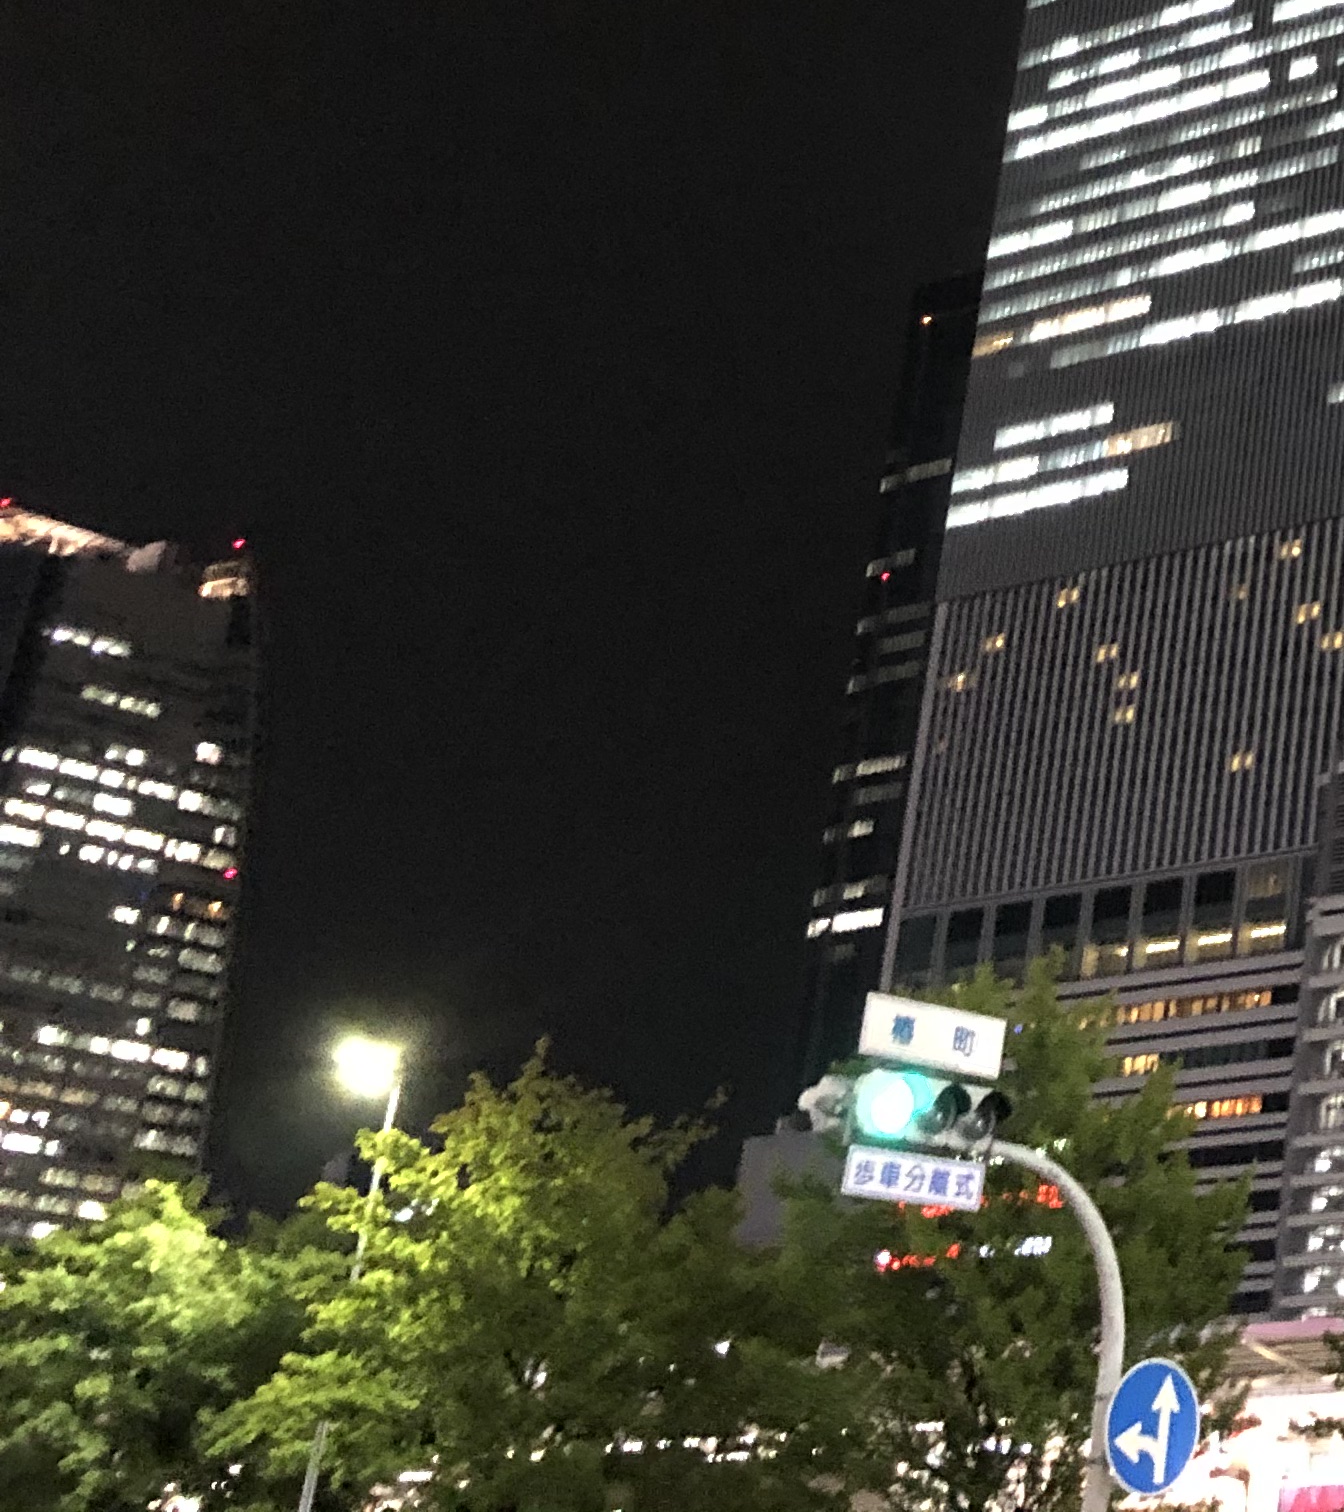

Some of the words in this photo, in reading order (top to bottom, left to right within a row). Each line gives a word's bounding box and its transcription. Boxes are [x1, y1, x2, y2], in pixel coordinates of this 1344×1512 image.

[853, 1159, 975, 1200] 歩車分離式
